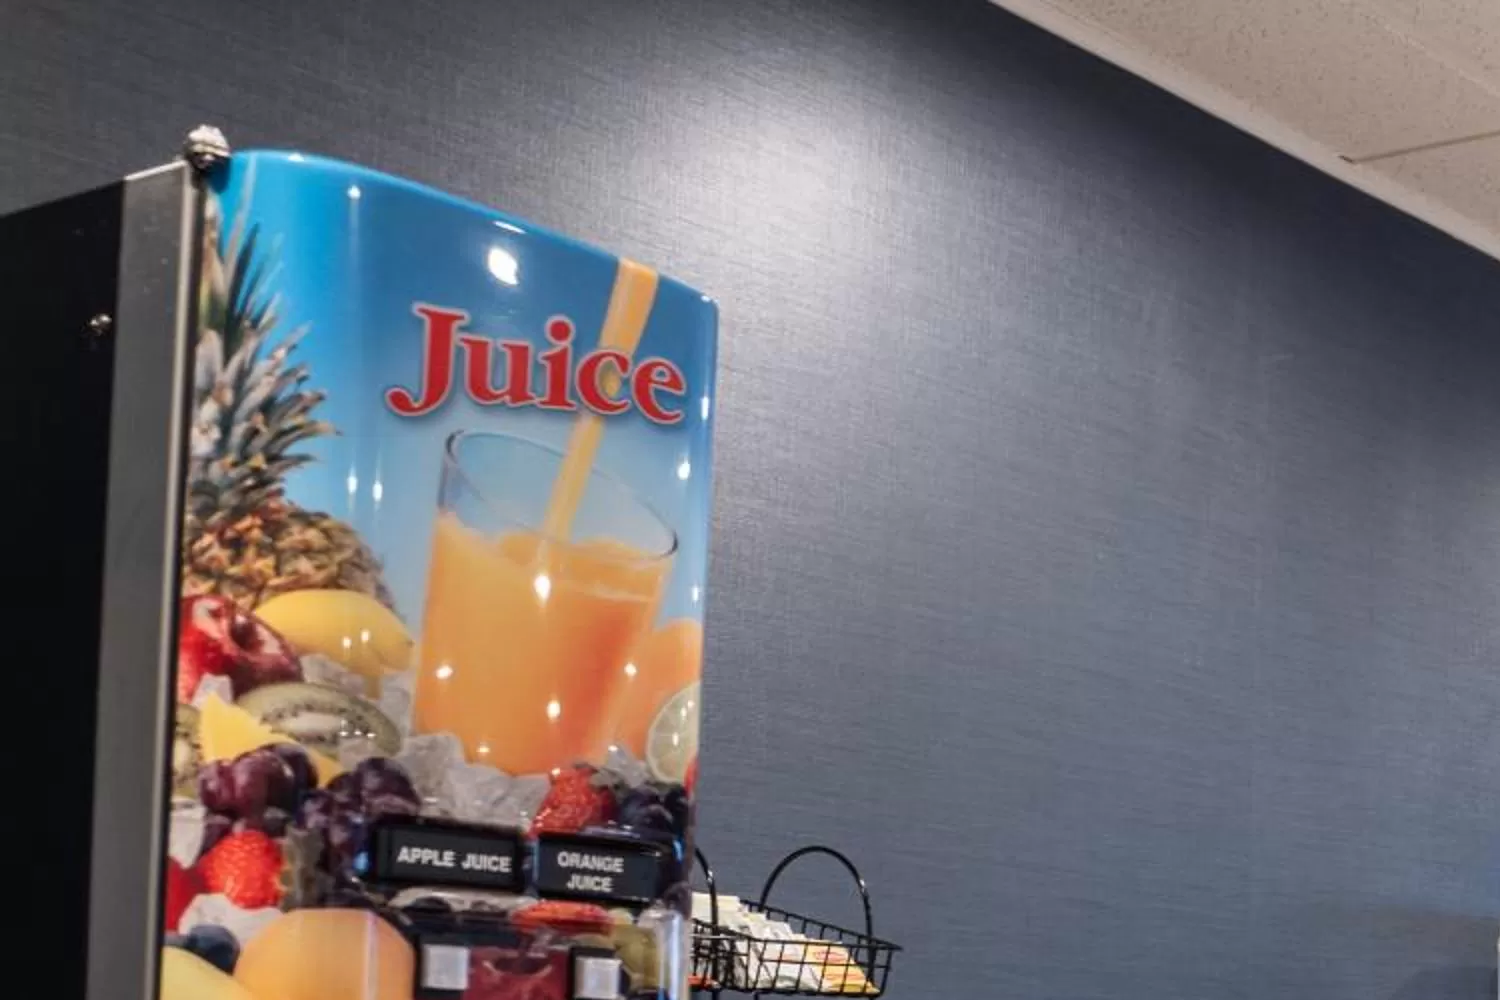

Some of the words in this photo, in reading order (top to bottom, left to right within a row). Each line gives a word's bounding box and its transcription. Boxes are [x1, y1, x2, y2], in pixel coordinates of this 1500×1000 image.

[385, 303, 685, 424] Juice
[398, 847, 455, 867] APPLE
[461, 853, 512, 873] JUICE
[557, 852, 624, 873] ORANGE
[566, 874, 613, 892] JUICE
